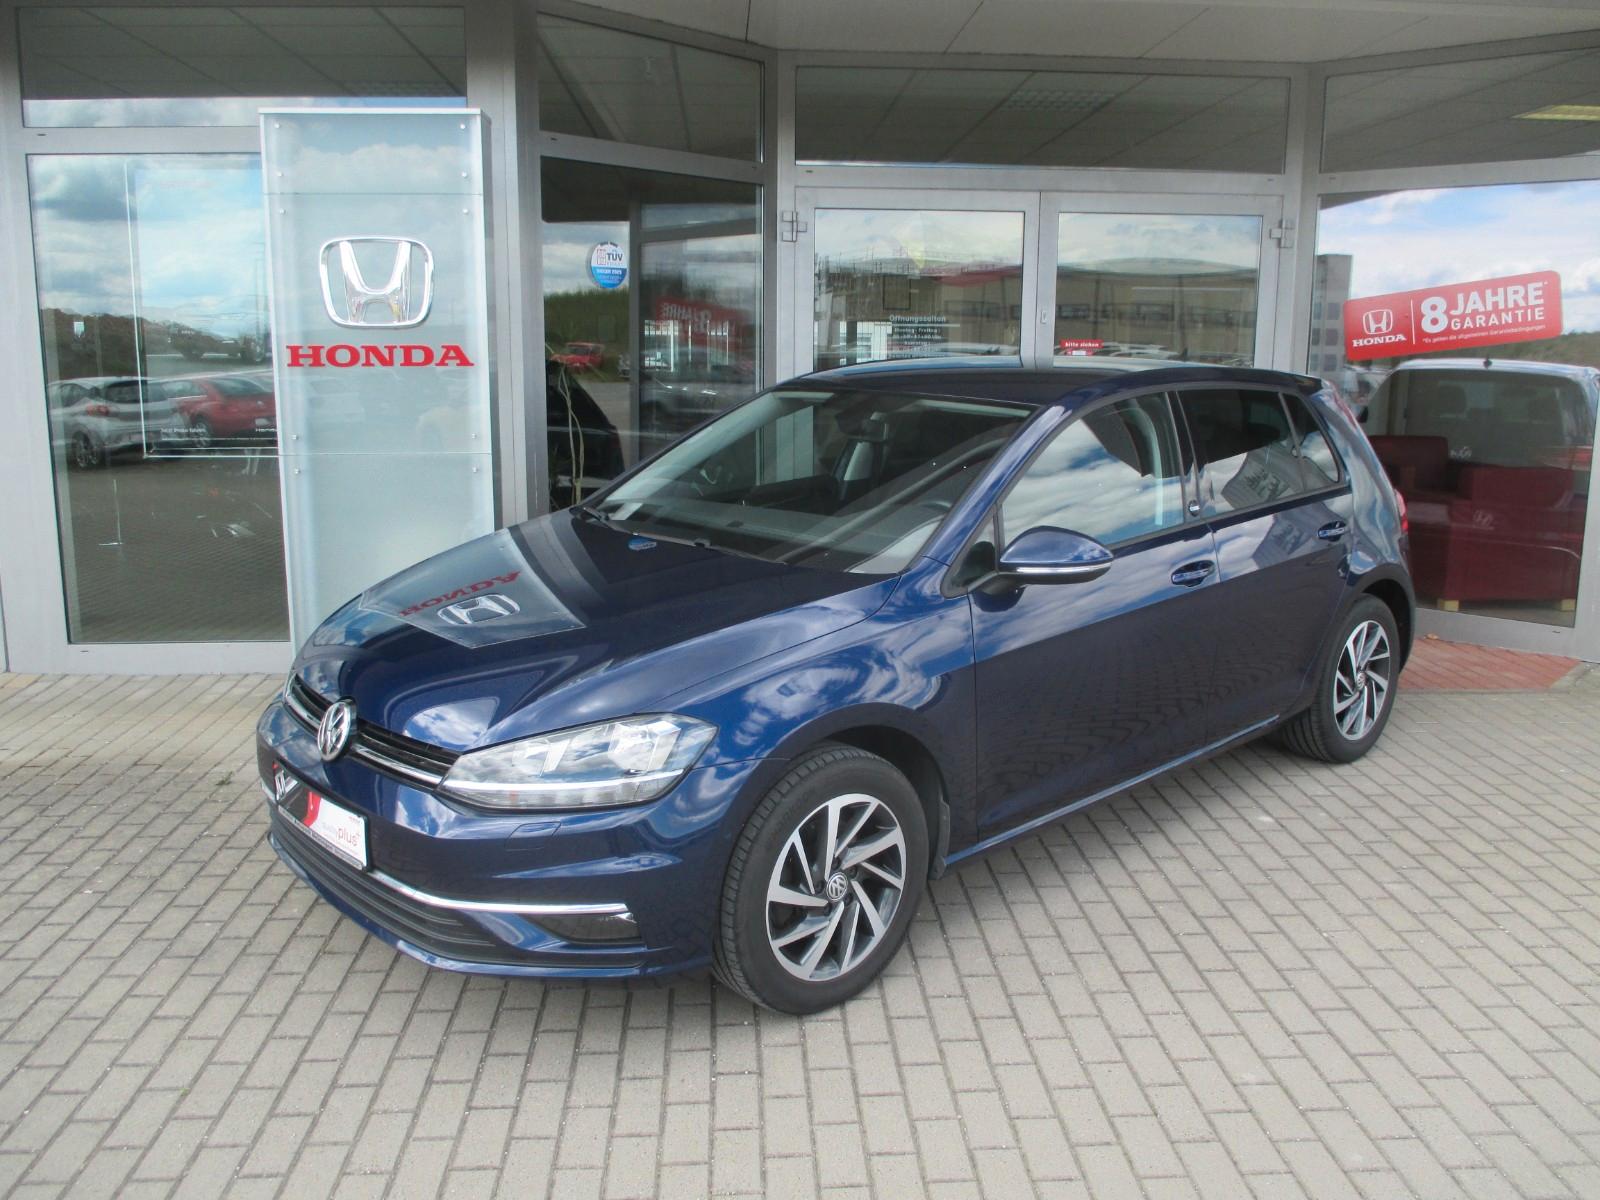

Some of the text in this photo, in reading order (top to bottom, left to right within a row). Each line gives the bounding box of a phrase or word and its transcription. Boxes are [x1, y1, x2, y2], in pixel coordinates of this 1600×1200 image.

[1420, 296, 1449, 334] 8
[1451, 307, 1545, 331] GARANTIE
[1352, 333, 1407, 348] HONDA
[286, 344, 475, 368] HONDA
